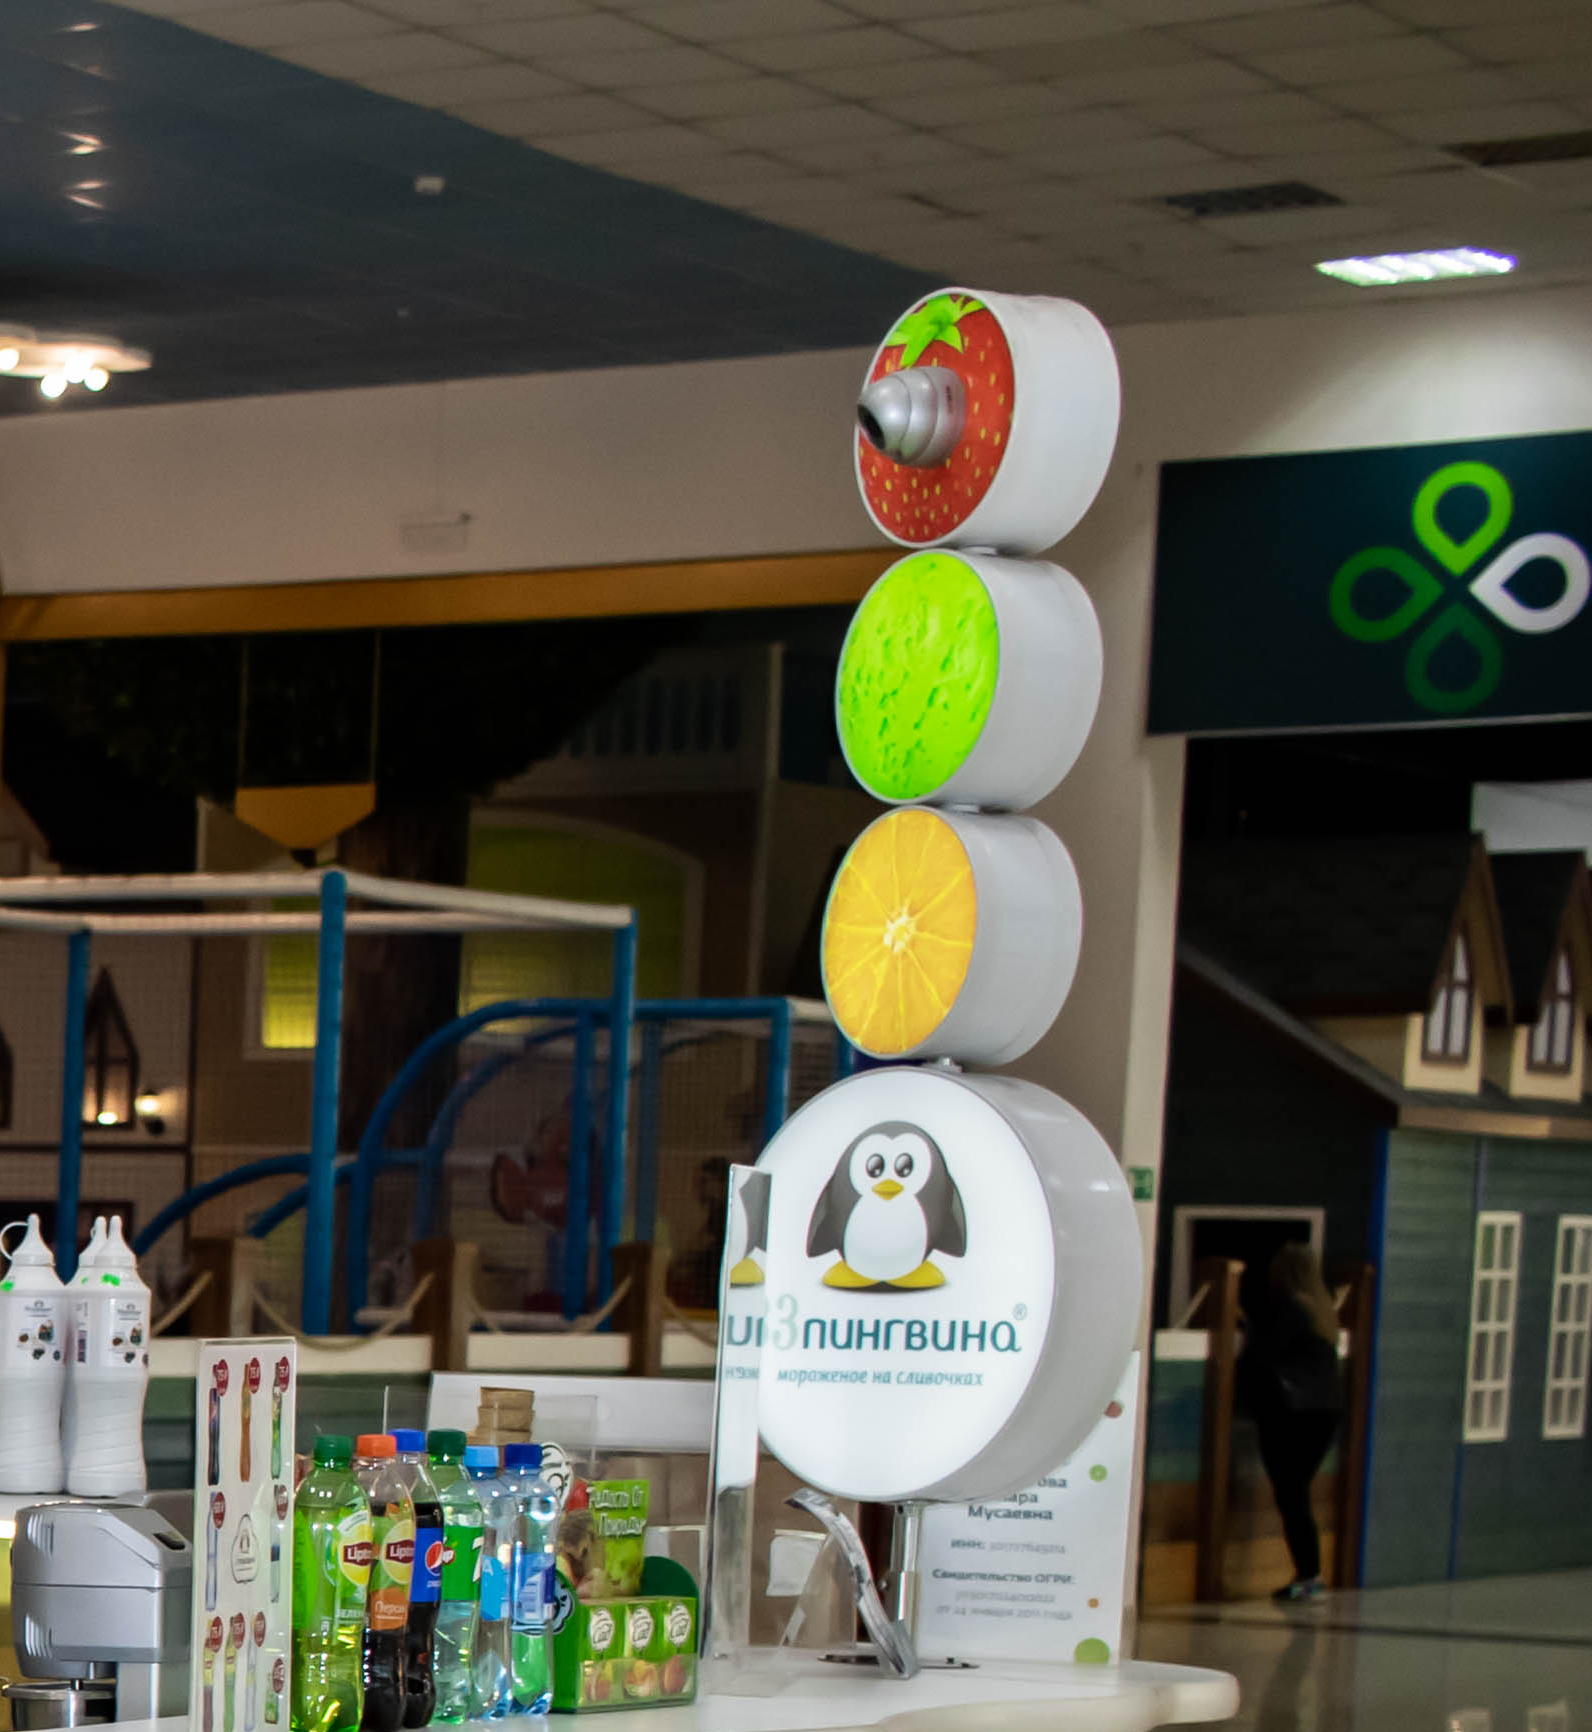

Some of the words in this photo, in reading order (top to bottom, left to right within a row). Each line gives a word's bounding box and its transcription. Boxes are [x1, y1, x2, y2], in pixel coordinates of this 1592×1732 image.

[763, 1293, 1022, 1353] 3пингвина
[871, 1367, 892, 1384] на
[896, 1369, 984, 1386] сливочках
[967, 1504, 1053, 1520] Мусаевна
